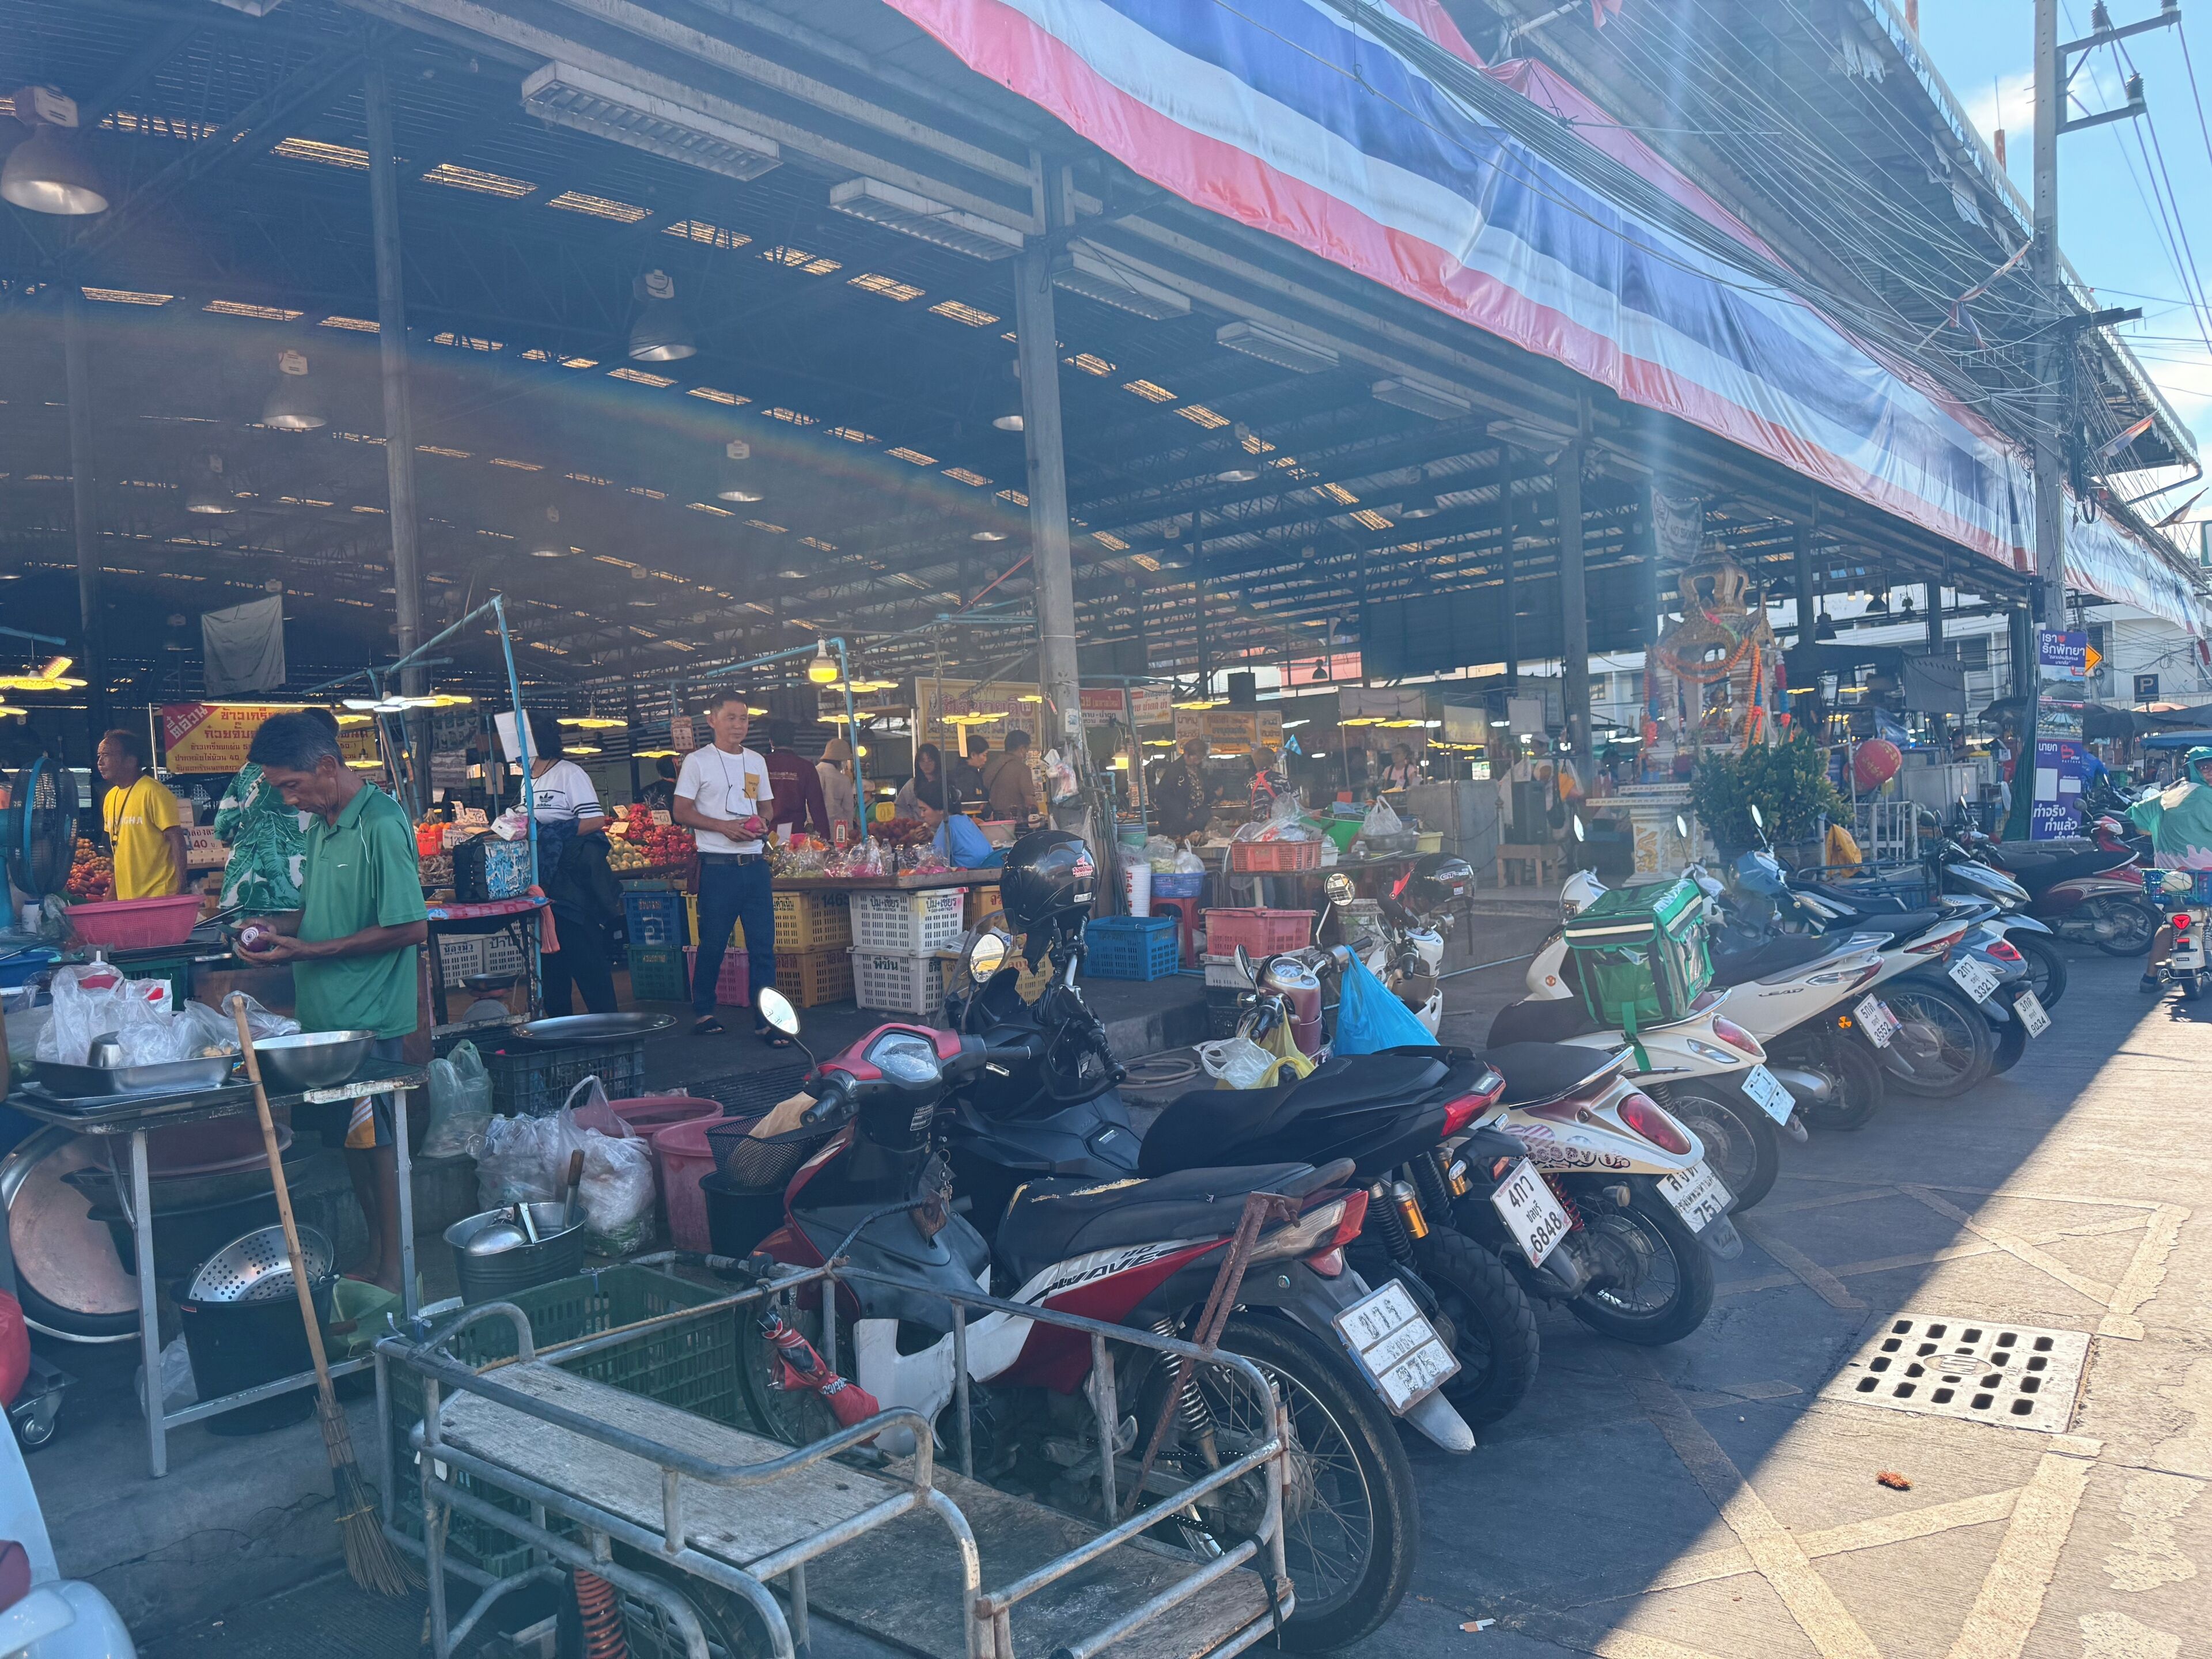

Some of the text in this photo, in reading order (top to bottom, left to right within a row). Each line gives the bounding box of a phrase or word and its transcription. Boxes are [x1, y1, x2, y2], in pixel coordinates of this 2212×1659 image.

[2042, 634, 2057, 643] เรา
[2042, 642, 2085, 656] รักพัทยา
[2140, 677, 2154, 692] P
[2039, 743, 2057, 751] นายก
[2033, 804, 2066, 817] ทำจริง
[2045, 817, 2078, 831] ทำแล้ว
[194, 839, 208, 849] 40
[1974, 979, 1995, 998] 3321
[1874, 1021, 1892, 1041] 3552
[2031, 1016, 2047, 1034] 9034
[1478, 1077, 1494, 1090] HONDA
[1525, 1199, 1542, 1224] ชลบุรี
[1692, 1194, 1725, 1226] 751
[1530, 1211, 1562, 1253] 6848
[1120, 1244, 1157, 1259] 110
[1055, 1251, 1160, 1289] WAVE
